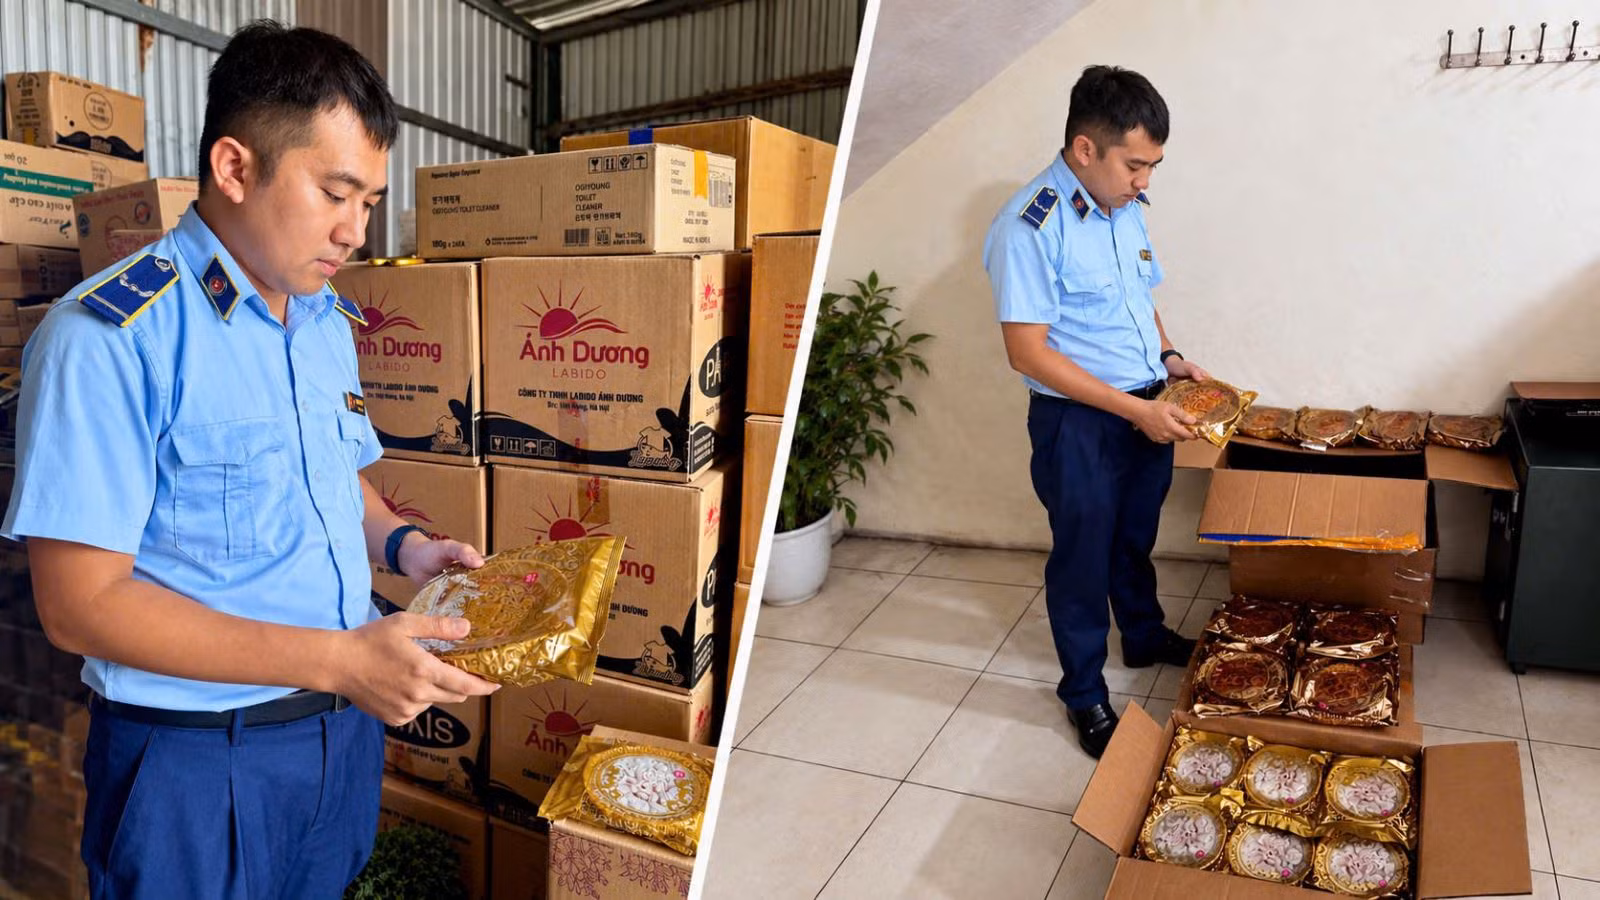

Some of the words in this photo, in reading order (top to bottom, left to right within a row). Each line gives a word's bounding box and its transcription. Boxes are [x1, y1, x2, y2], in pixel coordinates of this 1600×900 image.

[575, 193, 597, 202] TOILET
[575, 203, 603, 212] CLEANER
[357, 336, 377, 356] nh
[383, 336, 442, 363] Dương
[573, 341, 649, 369] Dương
[369, 362, 410, 372] LABIDO
[552, 367, 606, 379] LABIDO
